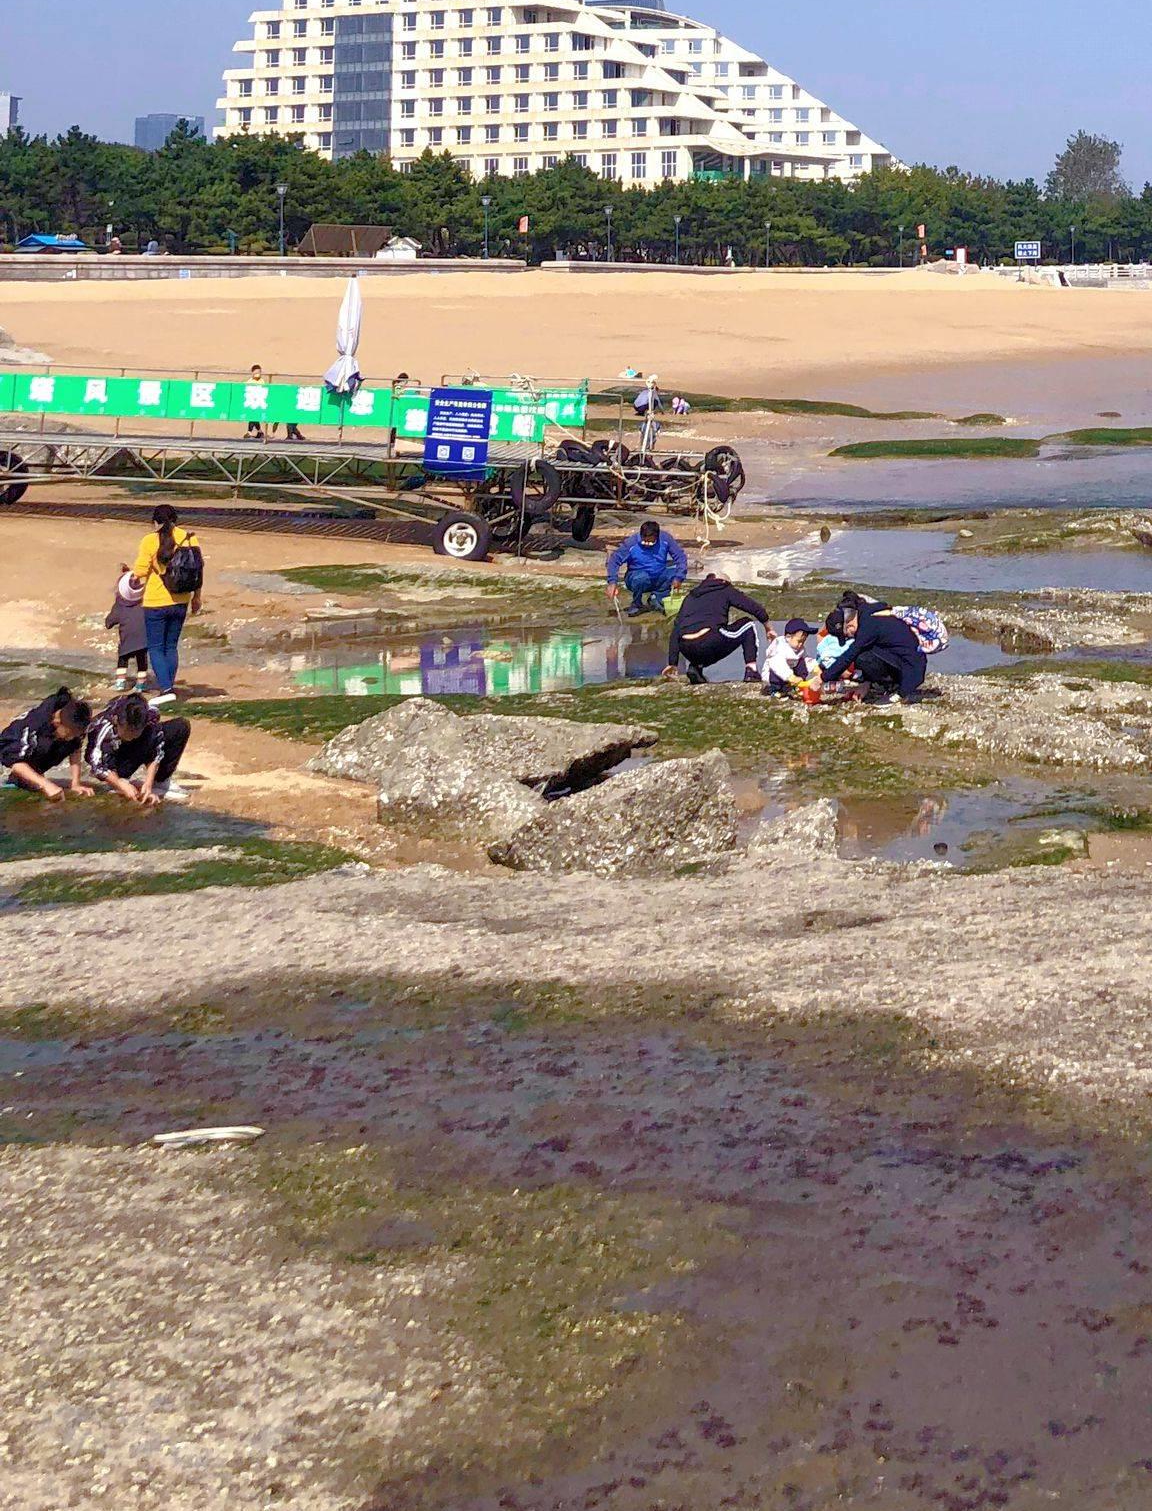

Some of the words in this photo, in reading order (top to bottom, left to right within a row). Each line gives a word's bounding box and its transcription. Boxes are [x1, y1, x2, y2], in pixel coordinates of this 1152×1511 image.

[0, 375, 375, 416] 塔风景区欢迎您
